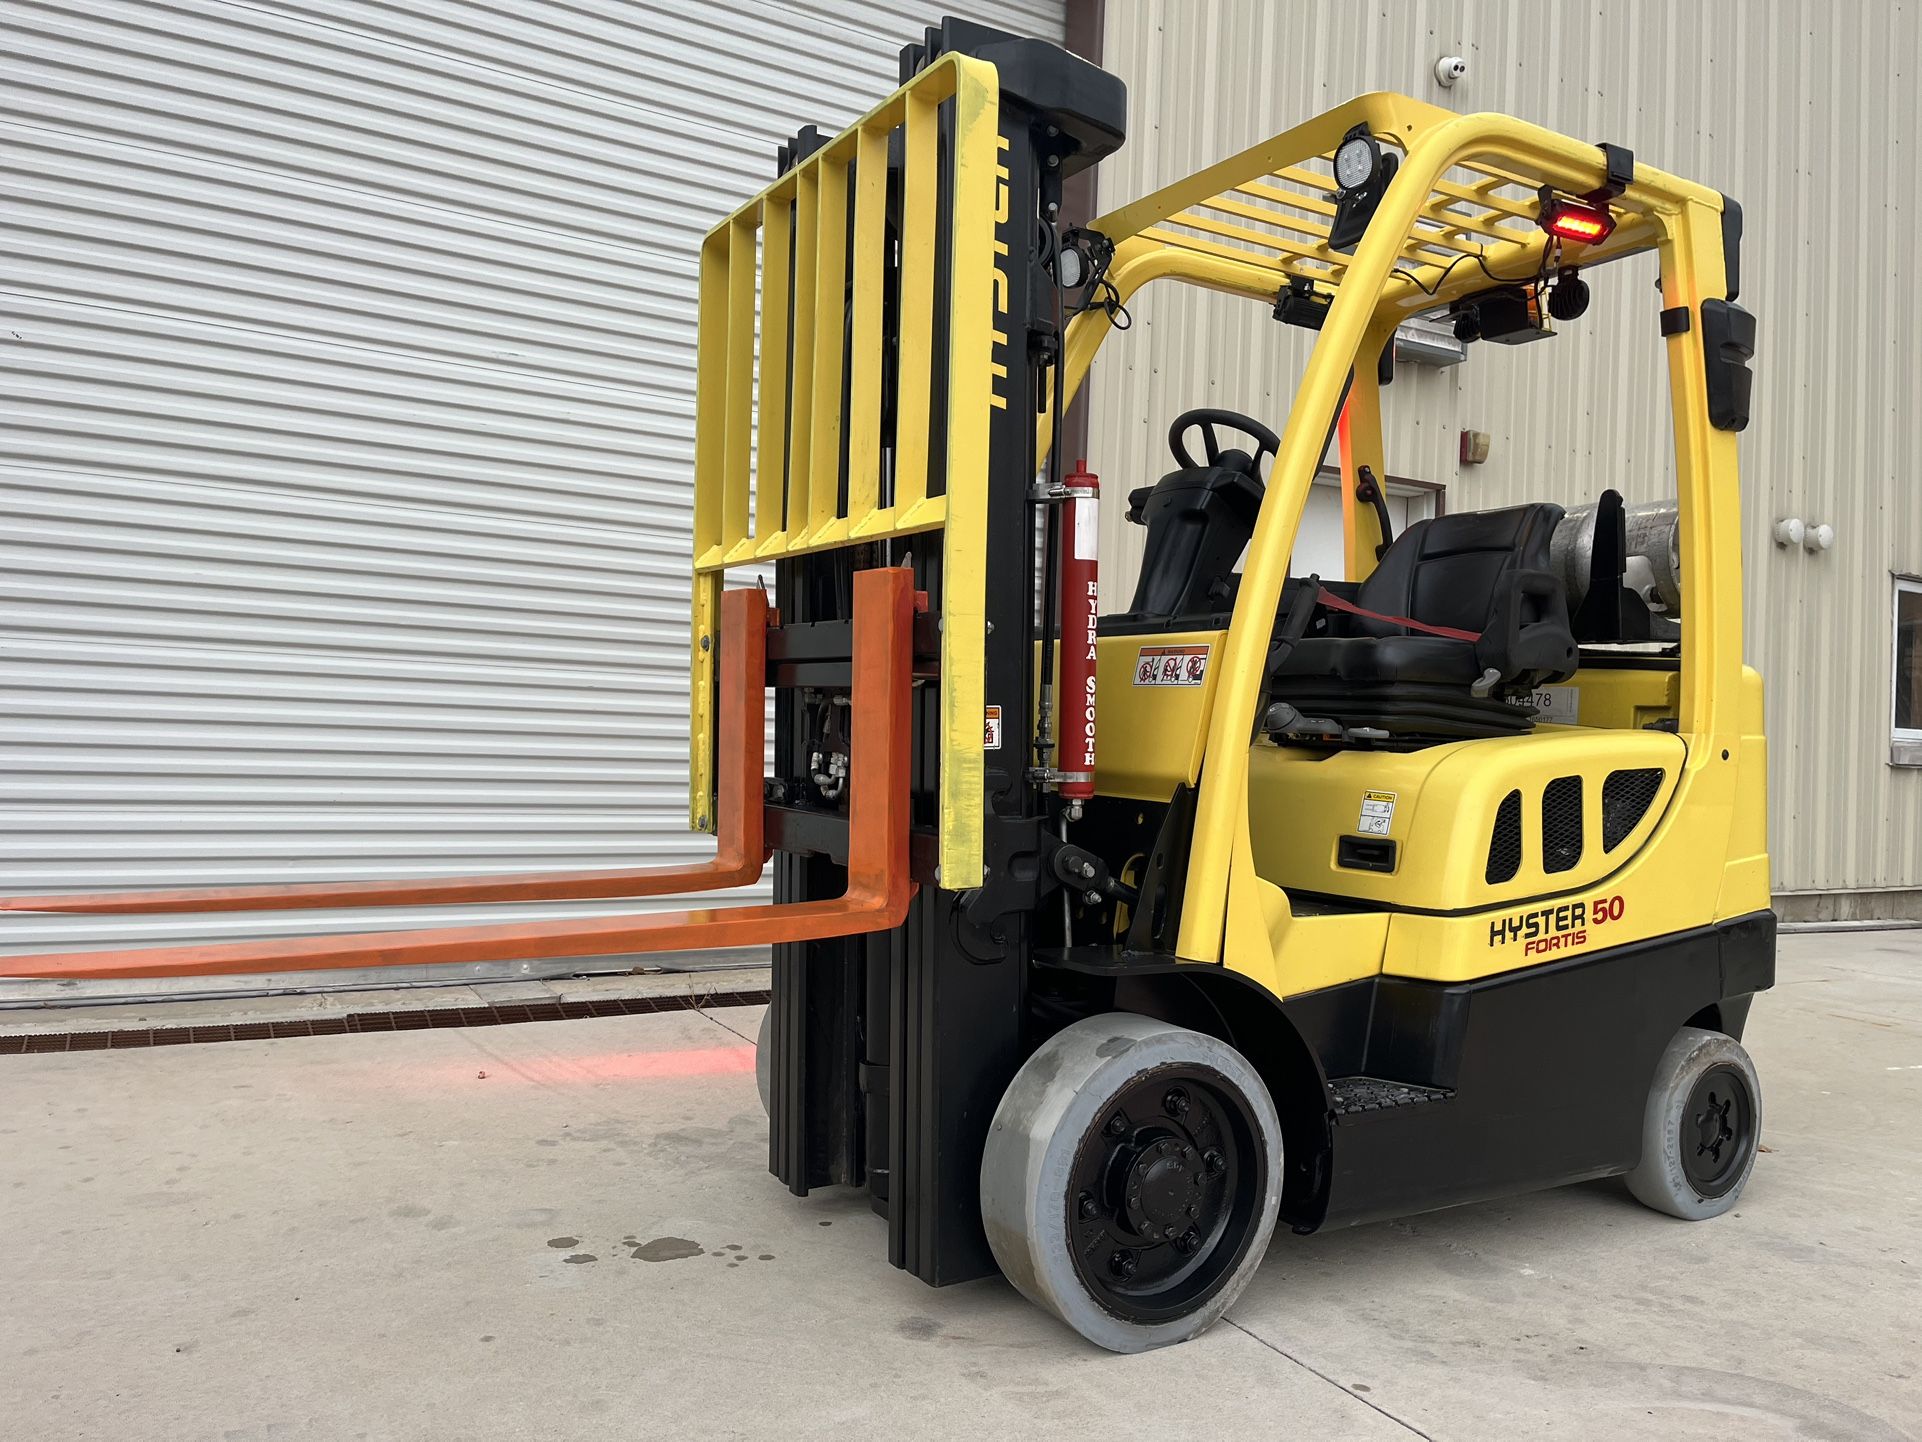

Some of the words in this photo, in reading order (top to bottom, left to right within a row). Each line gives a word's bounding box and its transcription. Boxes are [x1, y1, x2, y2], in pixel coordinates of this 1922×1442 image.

[1086, 581, 1098, 660] HYDRA
[1084, 675, 1096, 766] SMOOTH
[1489, 902, 1586, 947] HYSTER
[1592, 895, 1625, 926] 50
[1525, 930, 1587, 957] FORTIS
